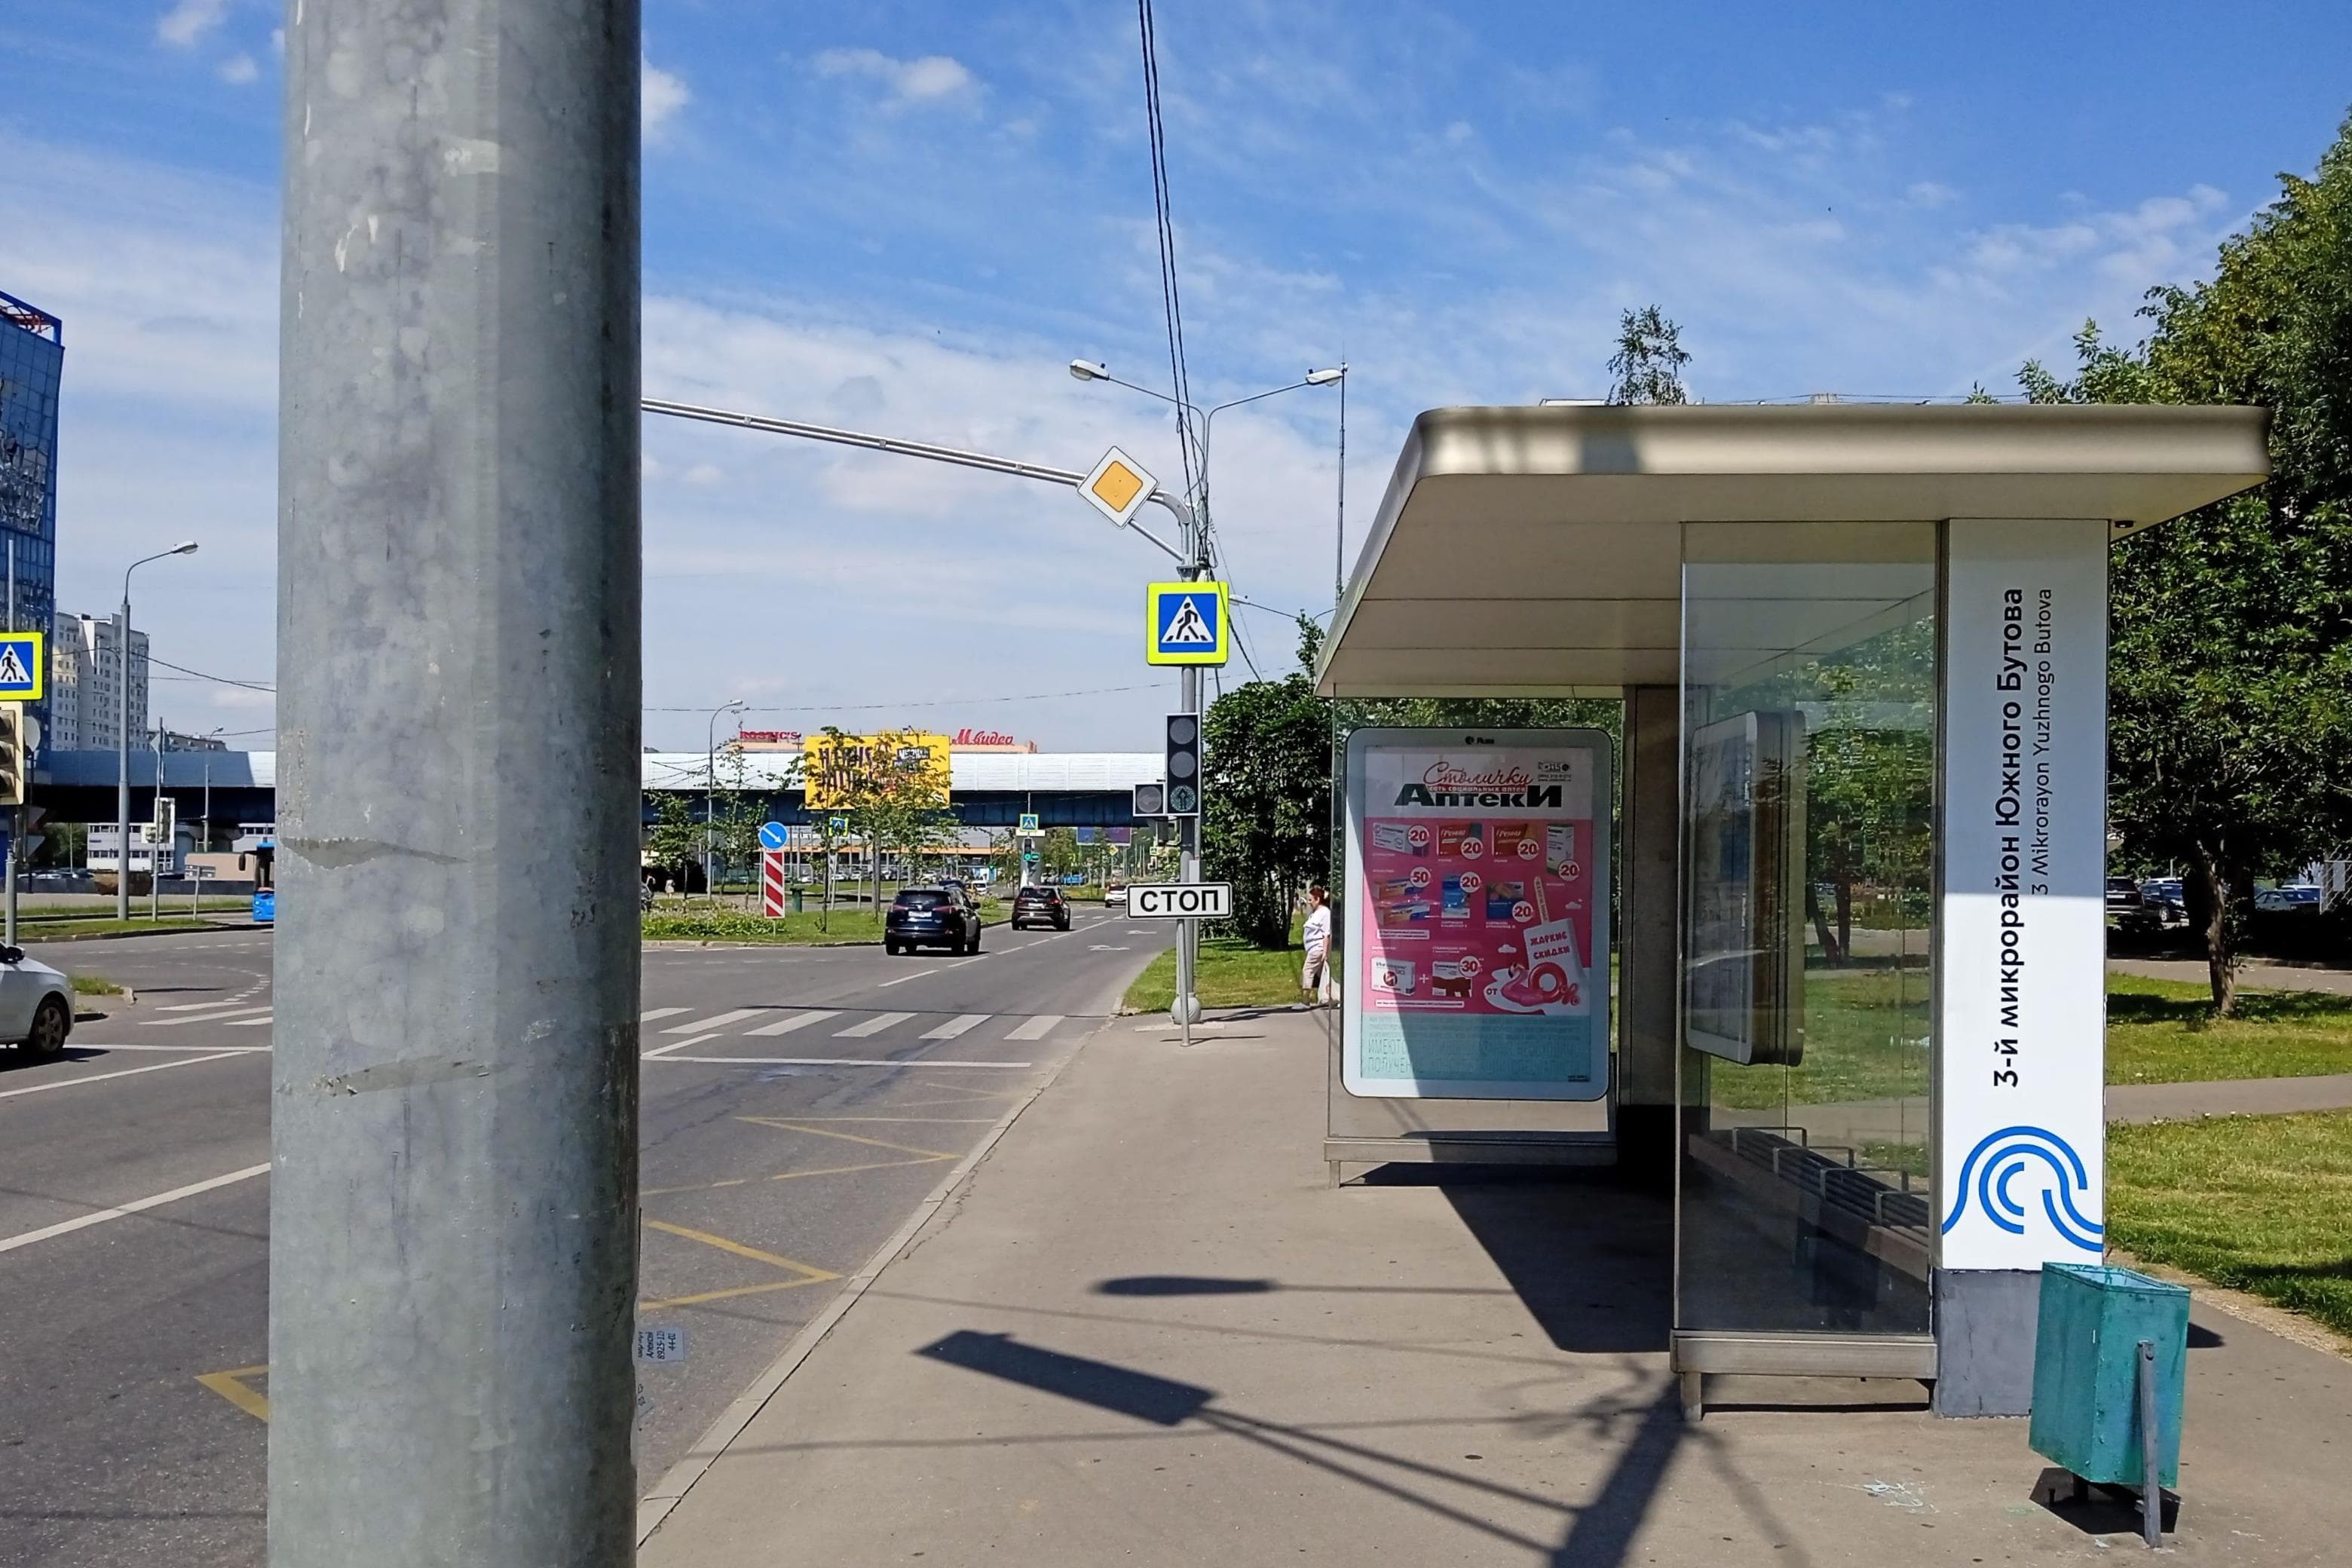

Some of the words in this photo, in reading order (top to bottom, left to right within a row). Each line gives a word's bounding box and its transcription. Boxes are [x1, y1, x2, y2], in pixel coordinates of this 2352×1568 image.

[1996, 589, 2028, 691] Бутова
[2034, 589, 2052, 654] Butova
[2032, 660, 2055, 756] Yuzhnogo
[1423, 761, 1534, 786] Столички
[1995, 701, 2022, 826] Южного
[2031, 762, 2053, 876] Mikrorayon
[1140, 890, 1219, 912] СТОП
[2032, 884, 2048, 896] 3
[1530, 930, 1568, 946] ЖАРКИЕ
[1533, 945, 1571, 960] СКИДКИ
[1995, 836, 2025, 1028] микрорайон
[1993, 1039, 2019, 1088] 3-й
